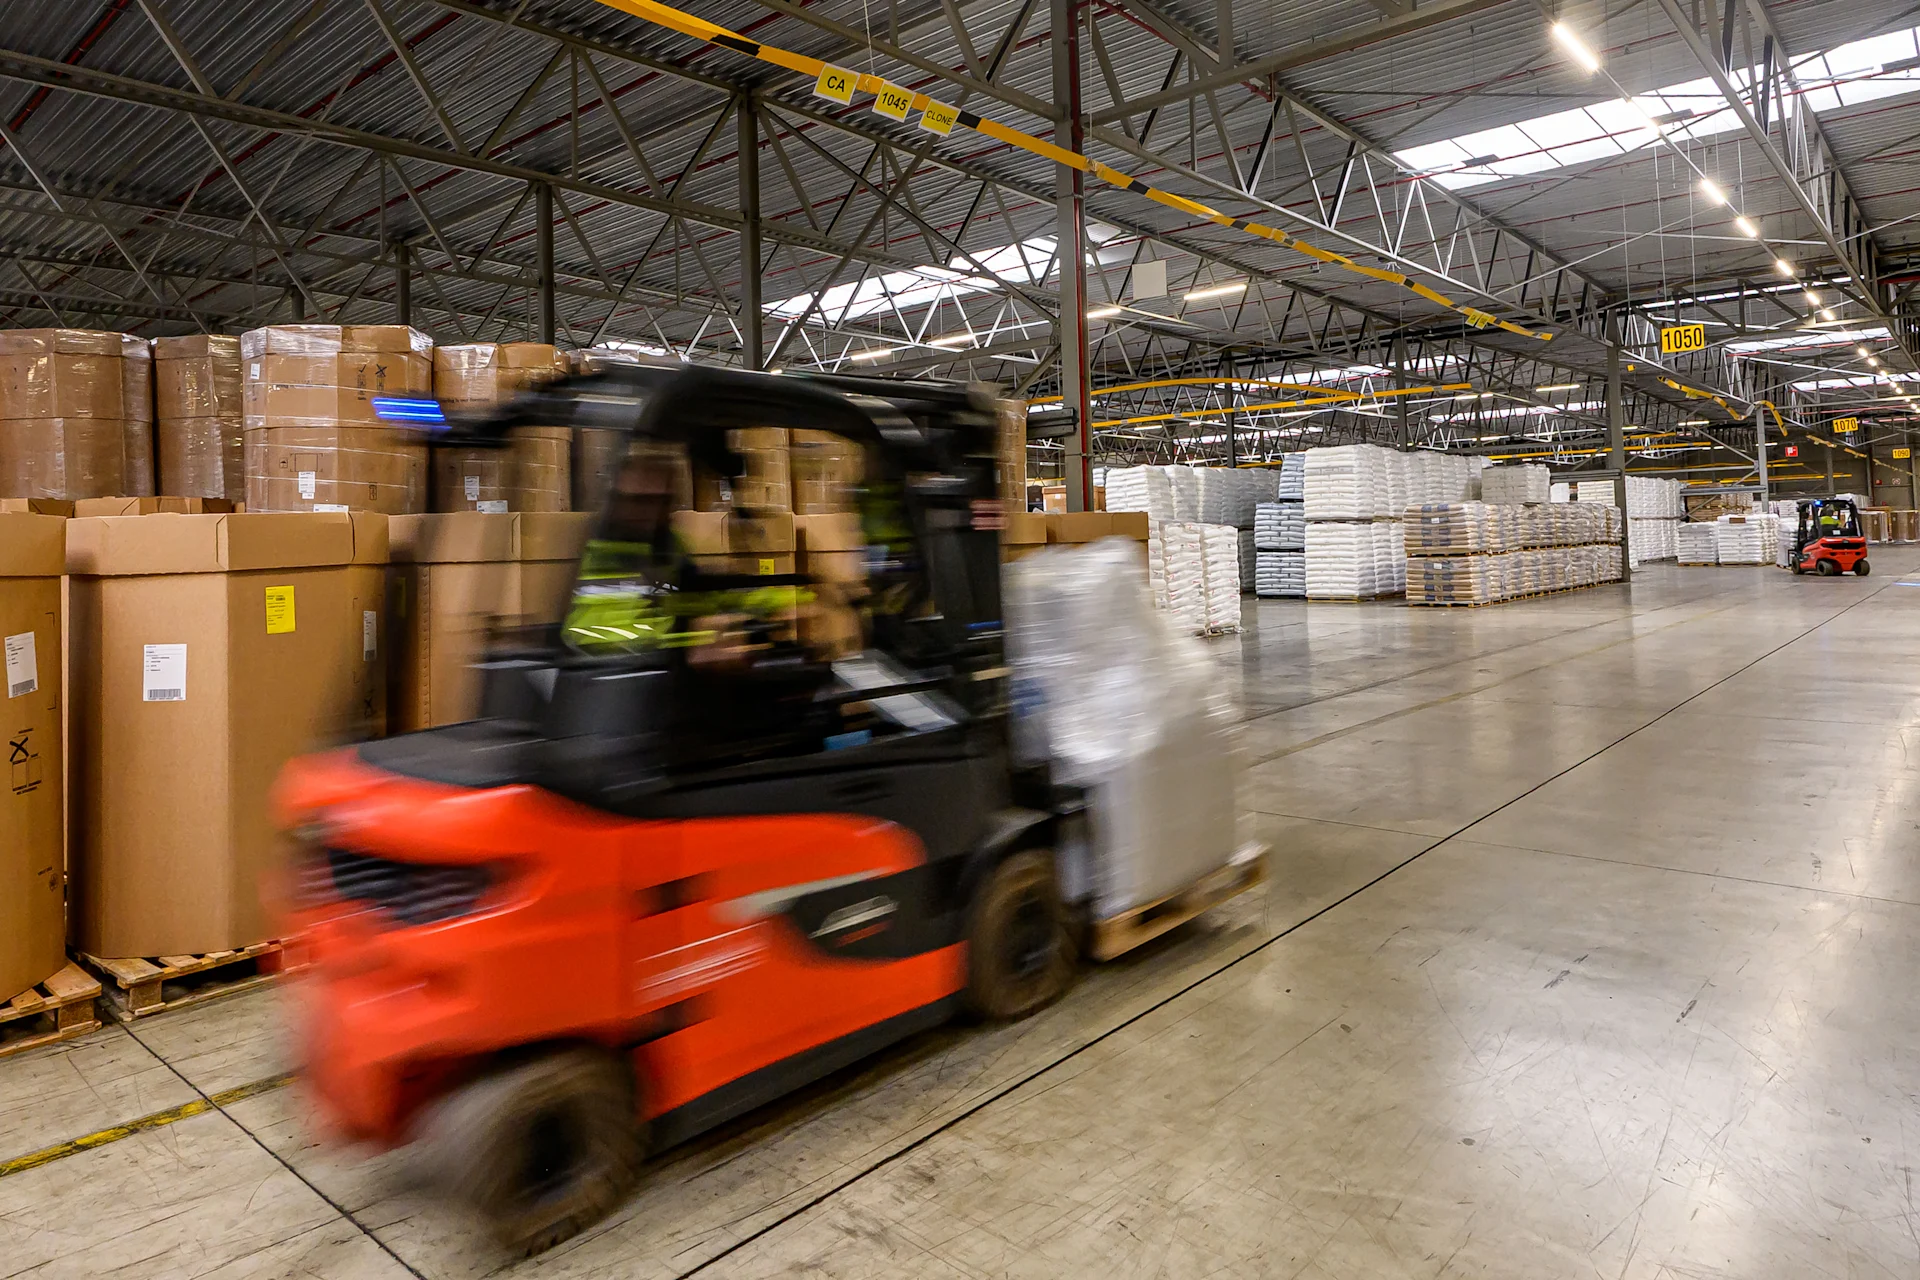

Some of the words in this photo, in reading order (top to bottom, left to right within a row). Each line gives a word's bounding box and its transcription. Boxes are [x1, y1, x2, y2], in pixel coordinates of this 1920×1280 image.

[827, 75, 845, 92] CA
[882, 92, 908, 111] 1045
[926, 110, 953, 126] CLONE
[1664, 327, 1703, 350] 1050
[1835, 418, 1856, 432] 1070
